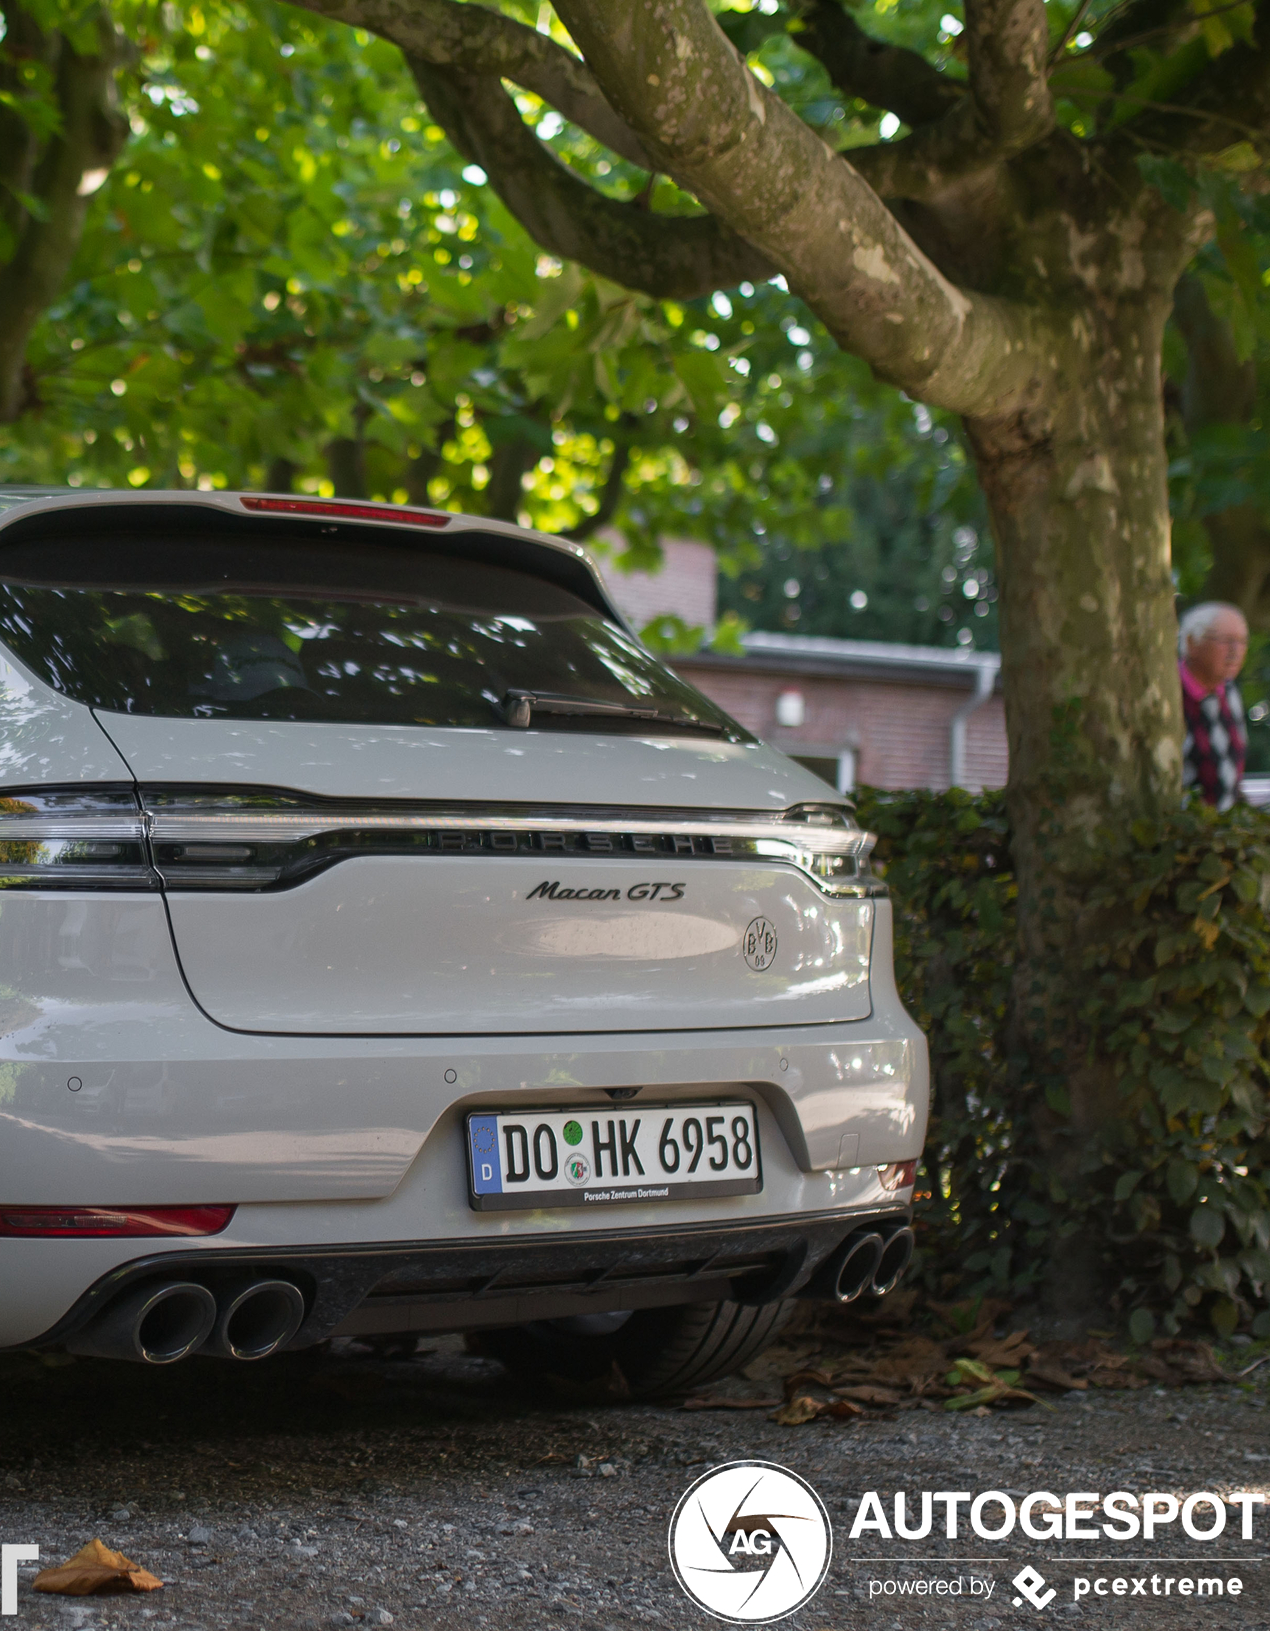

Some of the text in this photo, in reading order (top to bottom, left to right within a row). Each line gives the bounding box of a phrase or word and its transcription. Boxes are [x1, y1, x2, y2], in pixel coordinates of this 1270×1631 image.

[437, 831, 733, 855] PORSCHE
[526, 881, 687, 900] Macan GTS
[503, 1124, 559, 1182] DO
[592, 1119, 645, 1178] HK
[659, 1116, 753, 1175] 6958
[482, 1164, 493, 1181] D
[584, 1187, 668, 1201] Porsche Zentrum Dortmund
